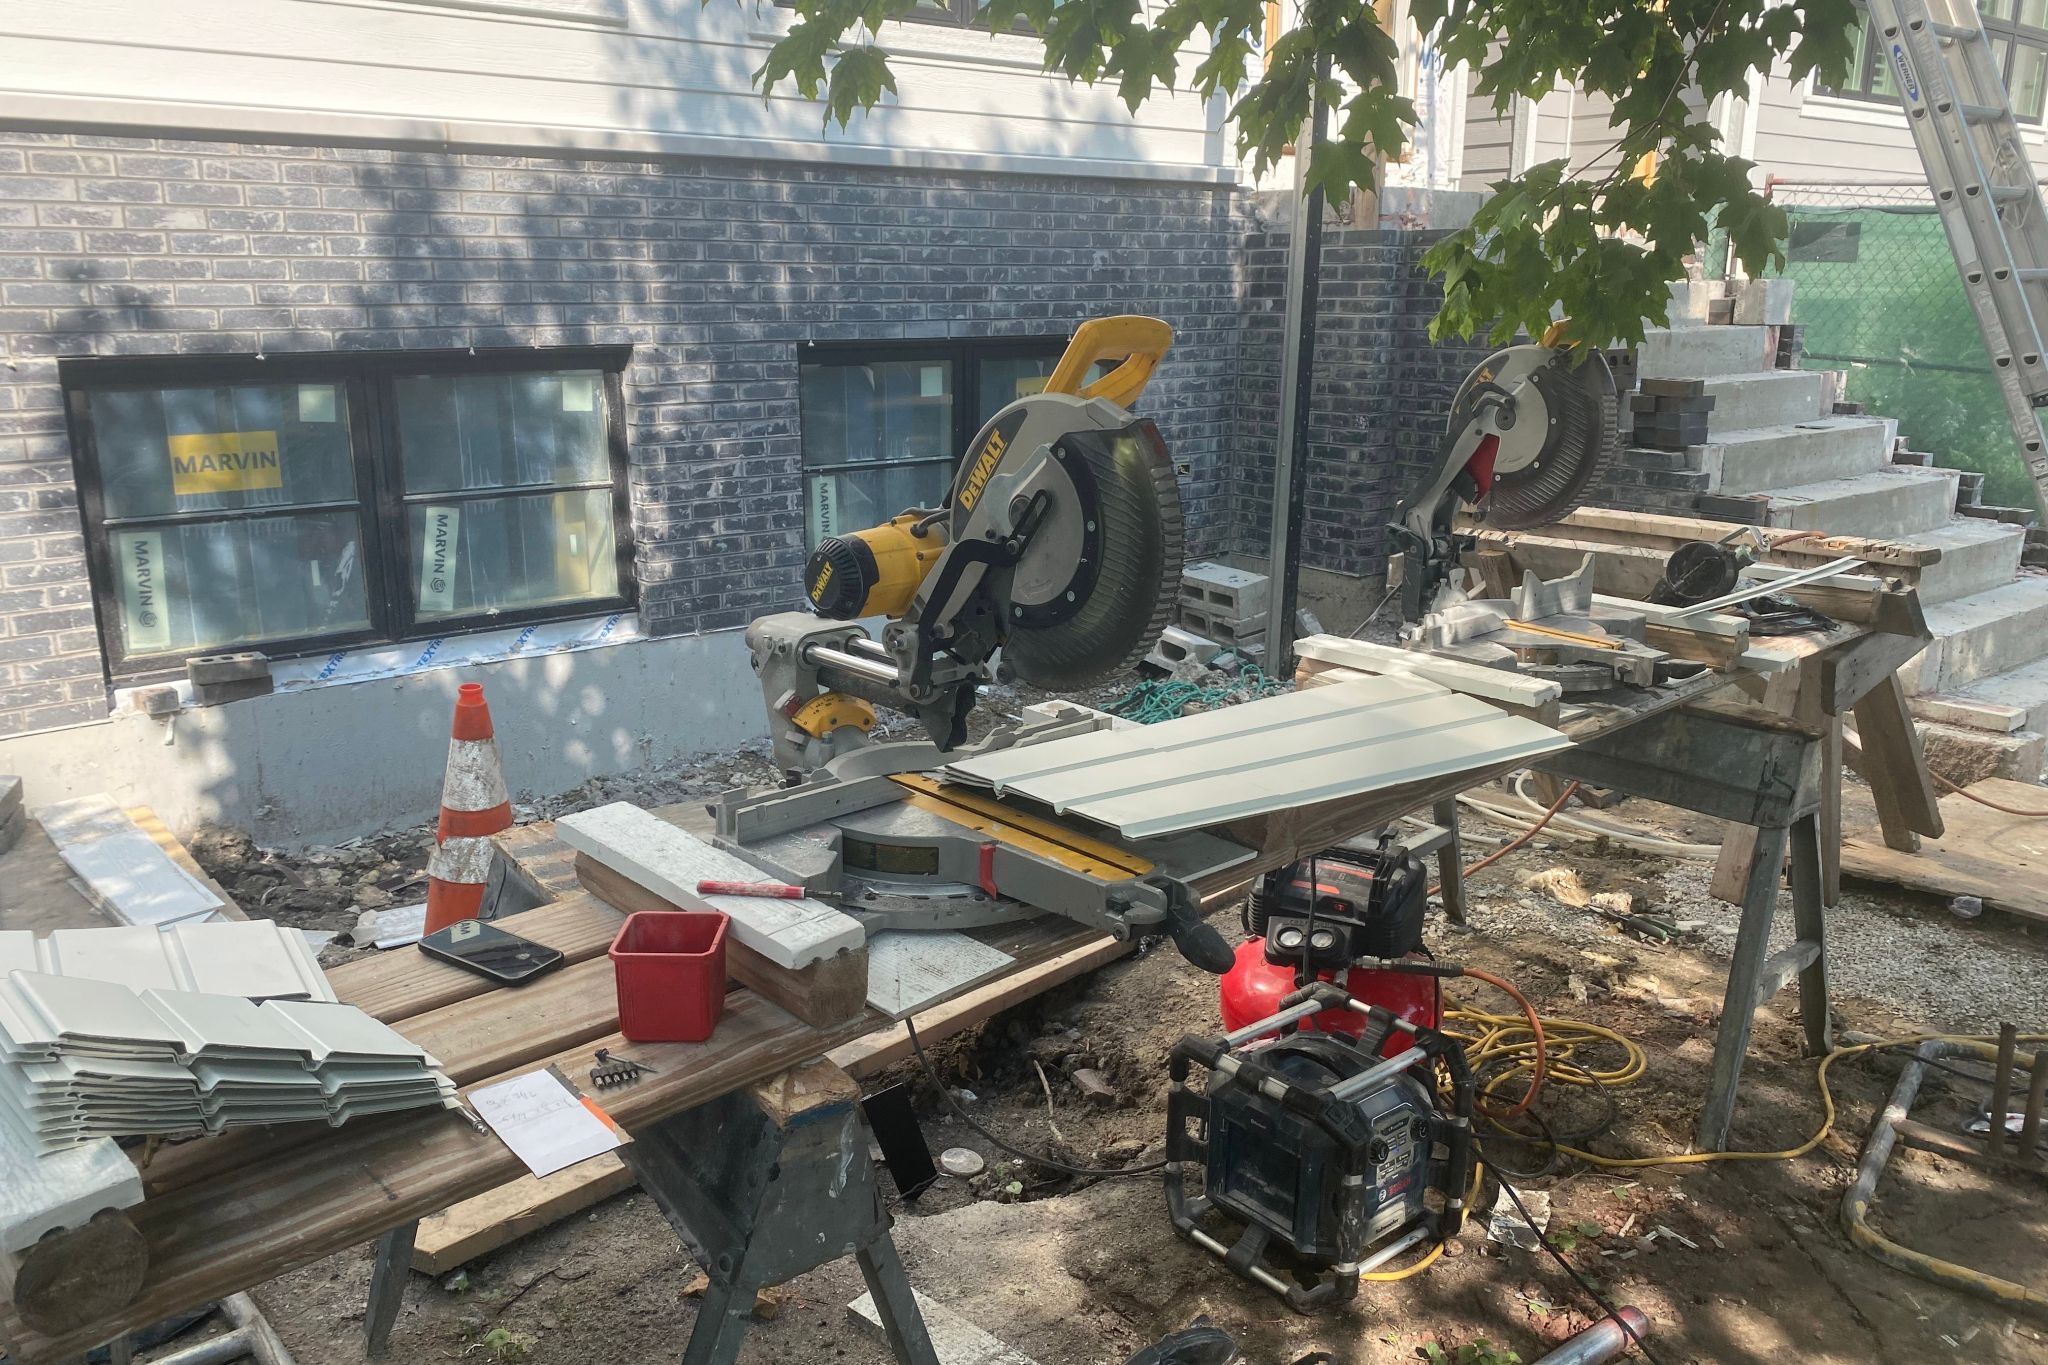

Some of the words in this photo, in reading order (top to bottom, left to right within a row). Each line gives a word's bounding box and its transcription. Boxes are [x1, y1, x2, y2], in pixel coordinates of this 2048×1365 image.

[1897, 55, 1915, 90] WERNER
[173, 450, 277, 474] MARVIN
[820, 482, 830, 533] MARVIN
[433, 514, 448, 573] MARVIN
[134, 540, 153, 606] MARVIN
